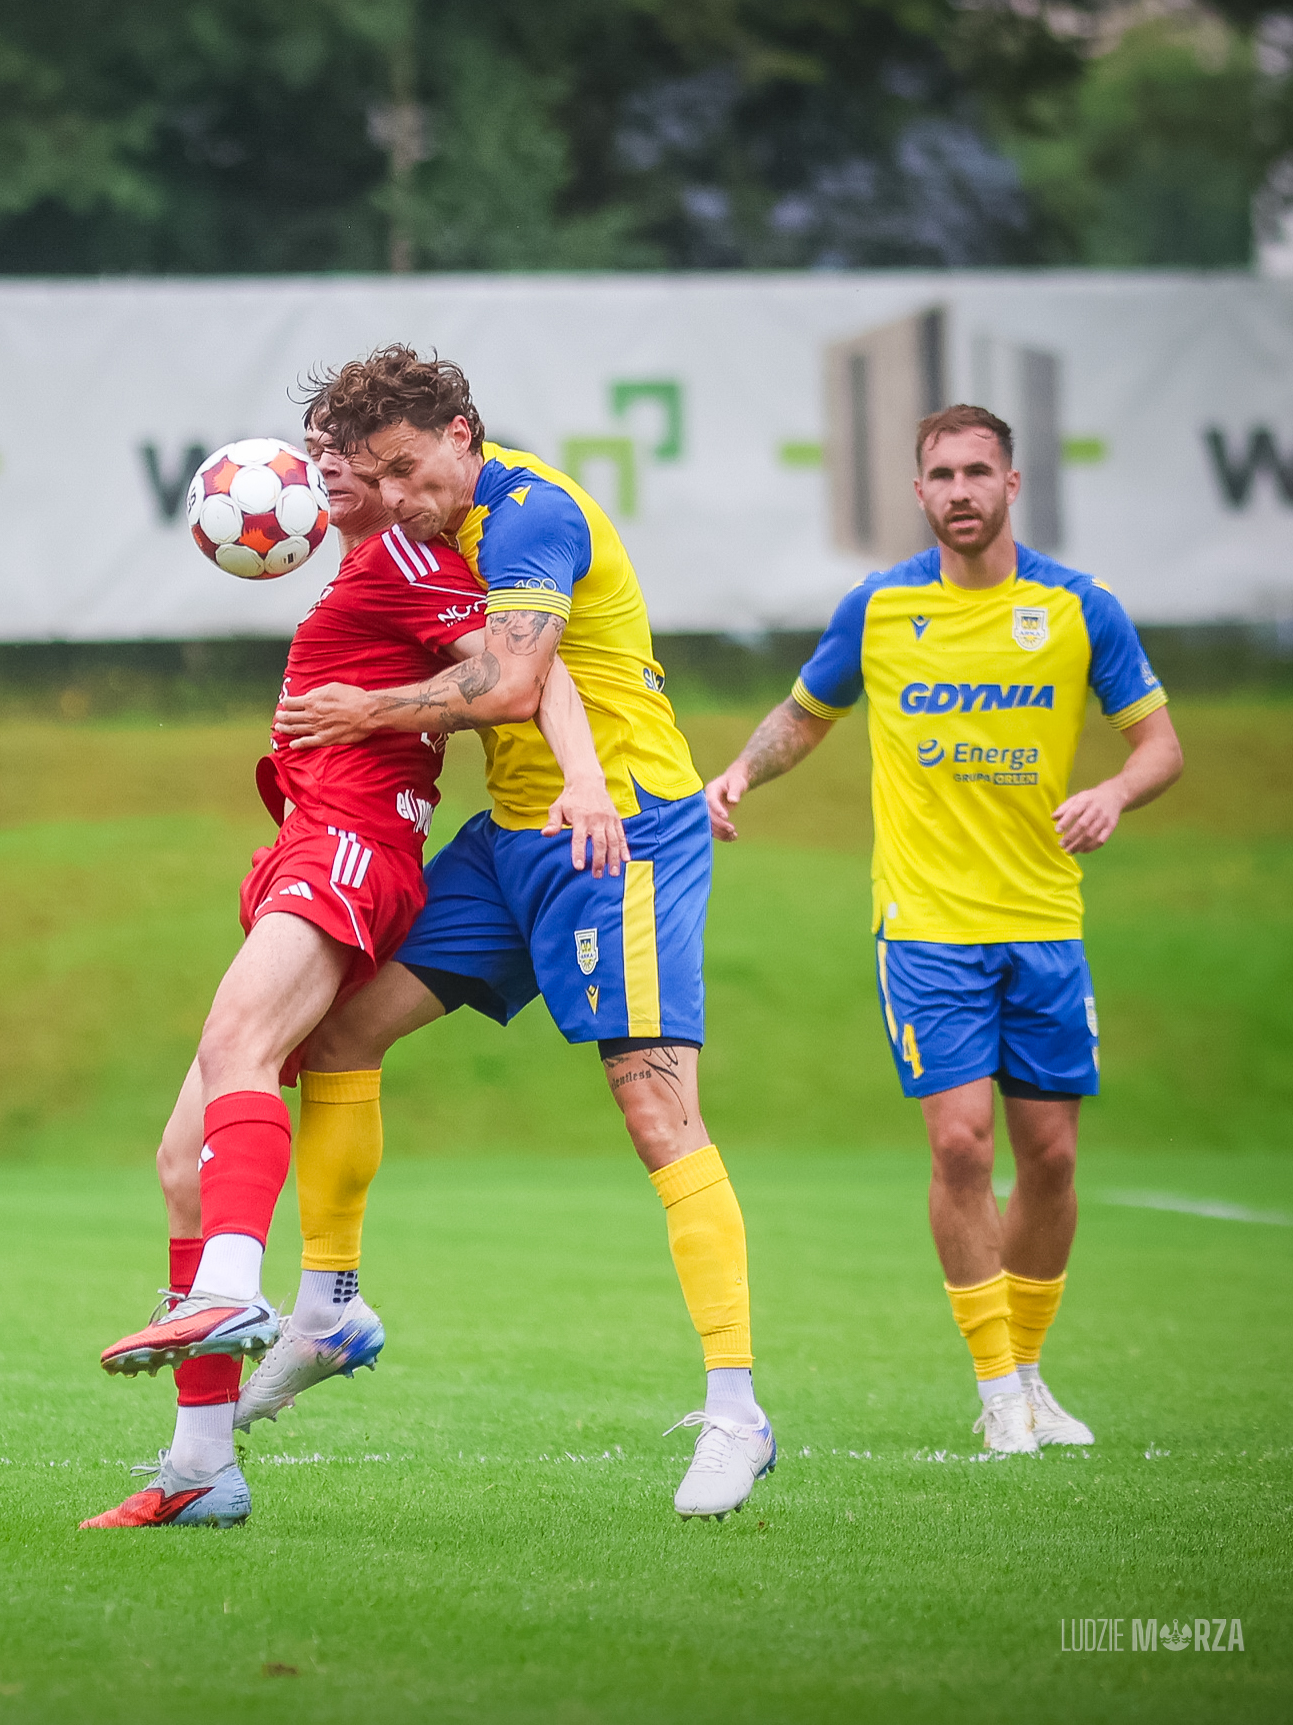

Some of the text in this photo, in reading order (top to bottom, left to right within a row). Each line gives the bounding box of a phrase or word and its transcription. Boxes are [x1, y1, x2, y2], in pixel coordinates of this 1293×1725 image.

[900, 682, 1055, 715] GDYNIA
[953, 743, 1039, 771] Energa
[995, 774, 1037, 784] ORLEN
[902, 1023, 925, 1080] 4
